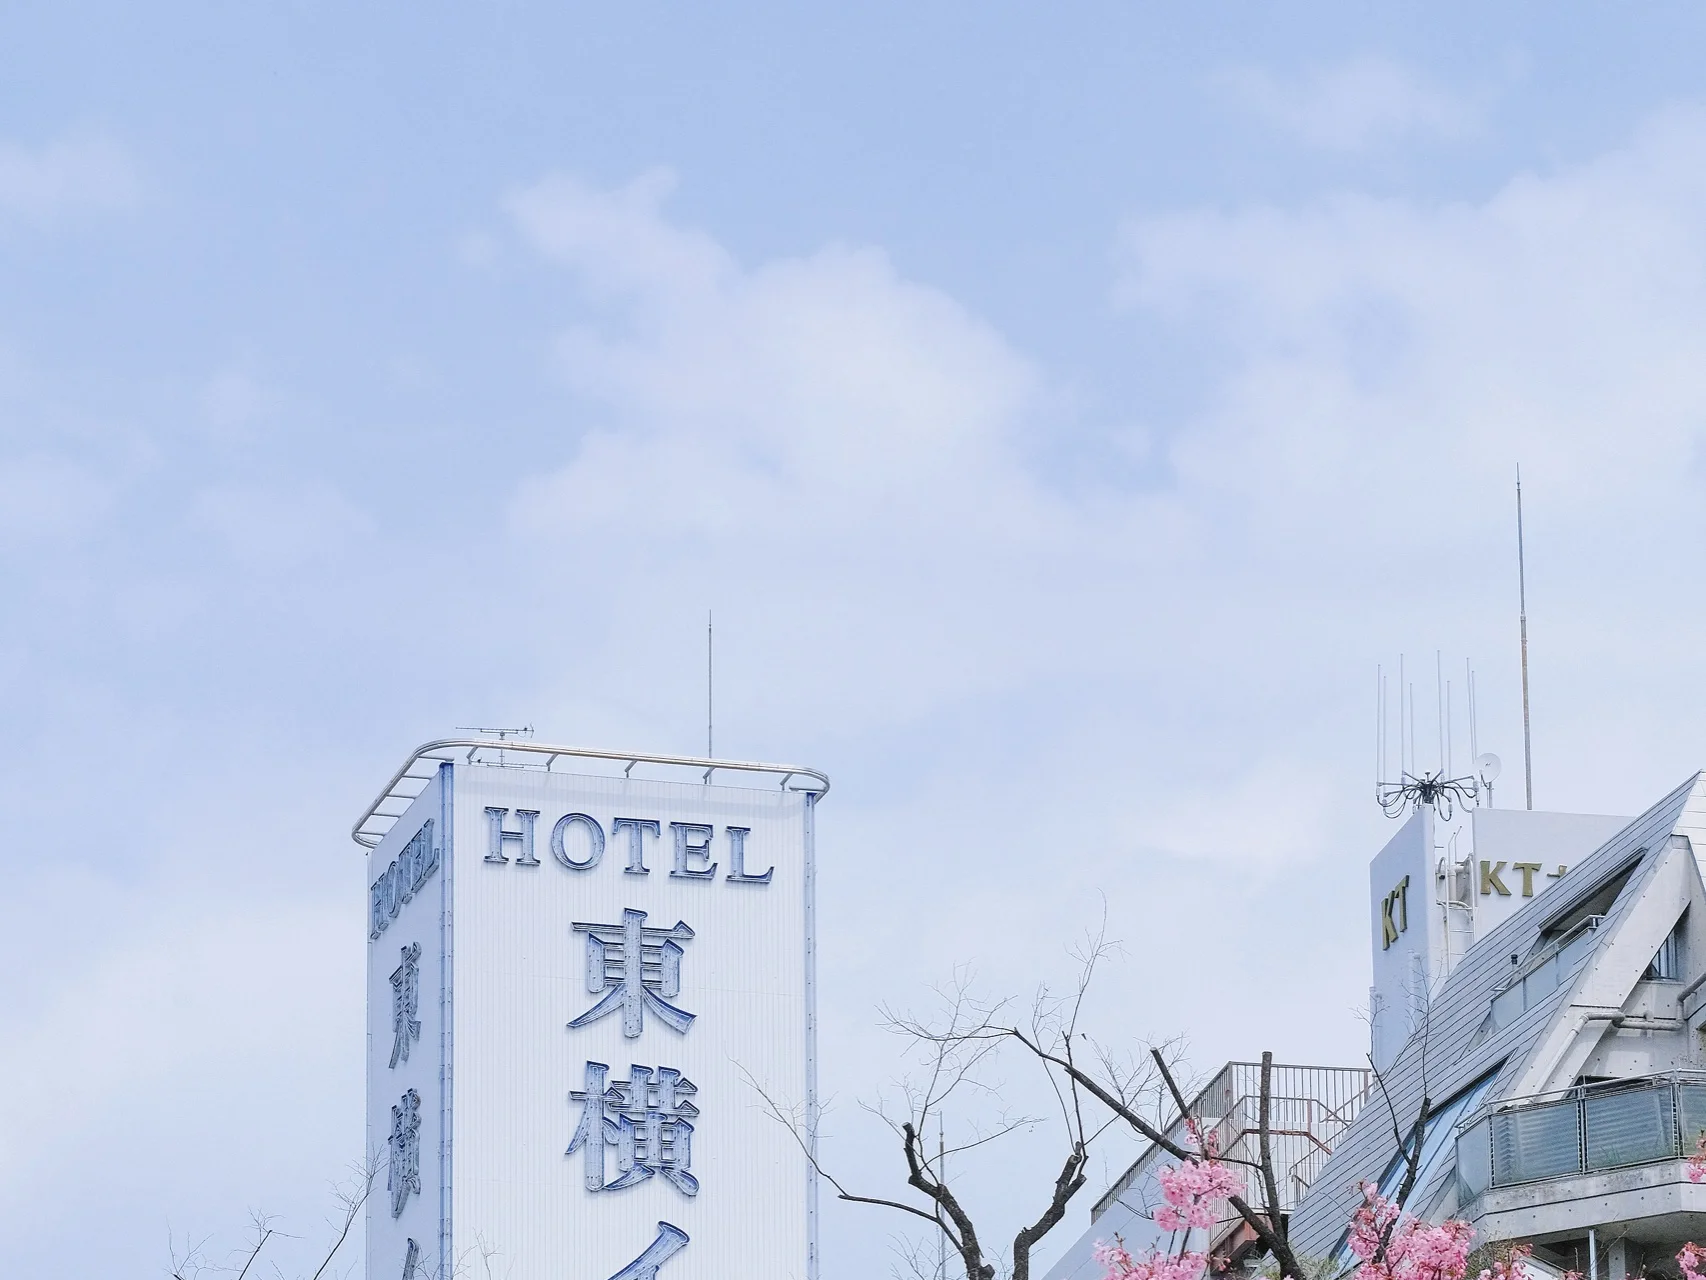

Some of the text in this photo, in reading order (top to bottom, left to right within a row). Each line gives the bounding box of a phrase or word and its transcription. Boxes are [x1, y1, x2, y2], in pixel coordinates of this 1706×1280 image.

[370, 817, 440, 940] HOTEL
[483, 805, 775, 885] HOTEL
[1380, 874, 1410, 952] KT
